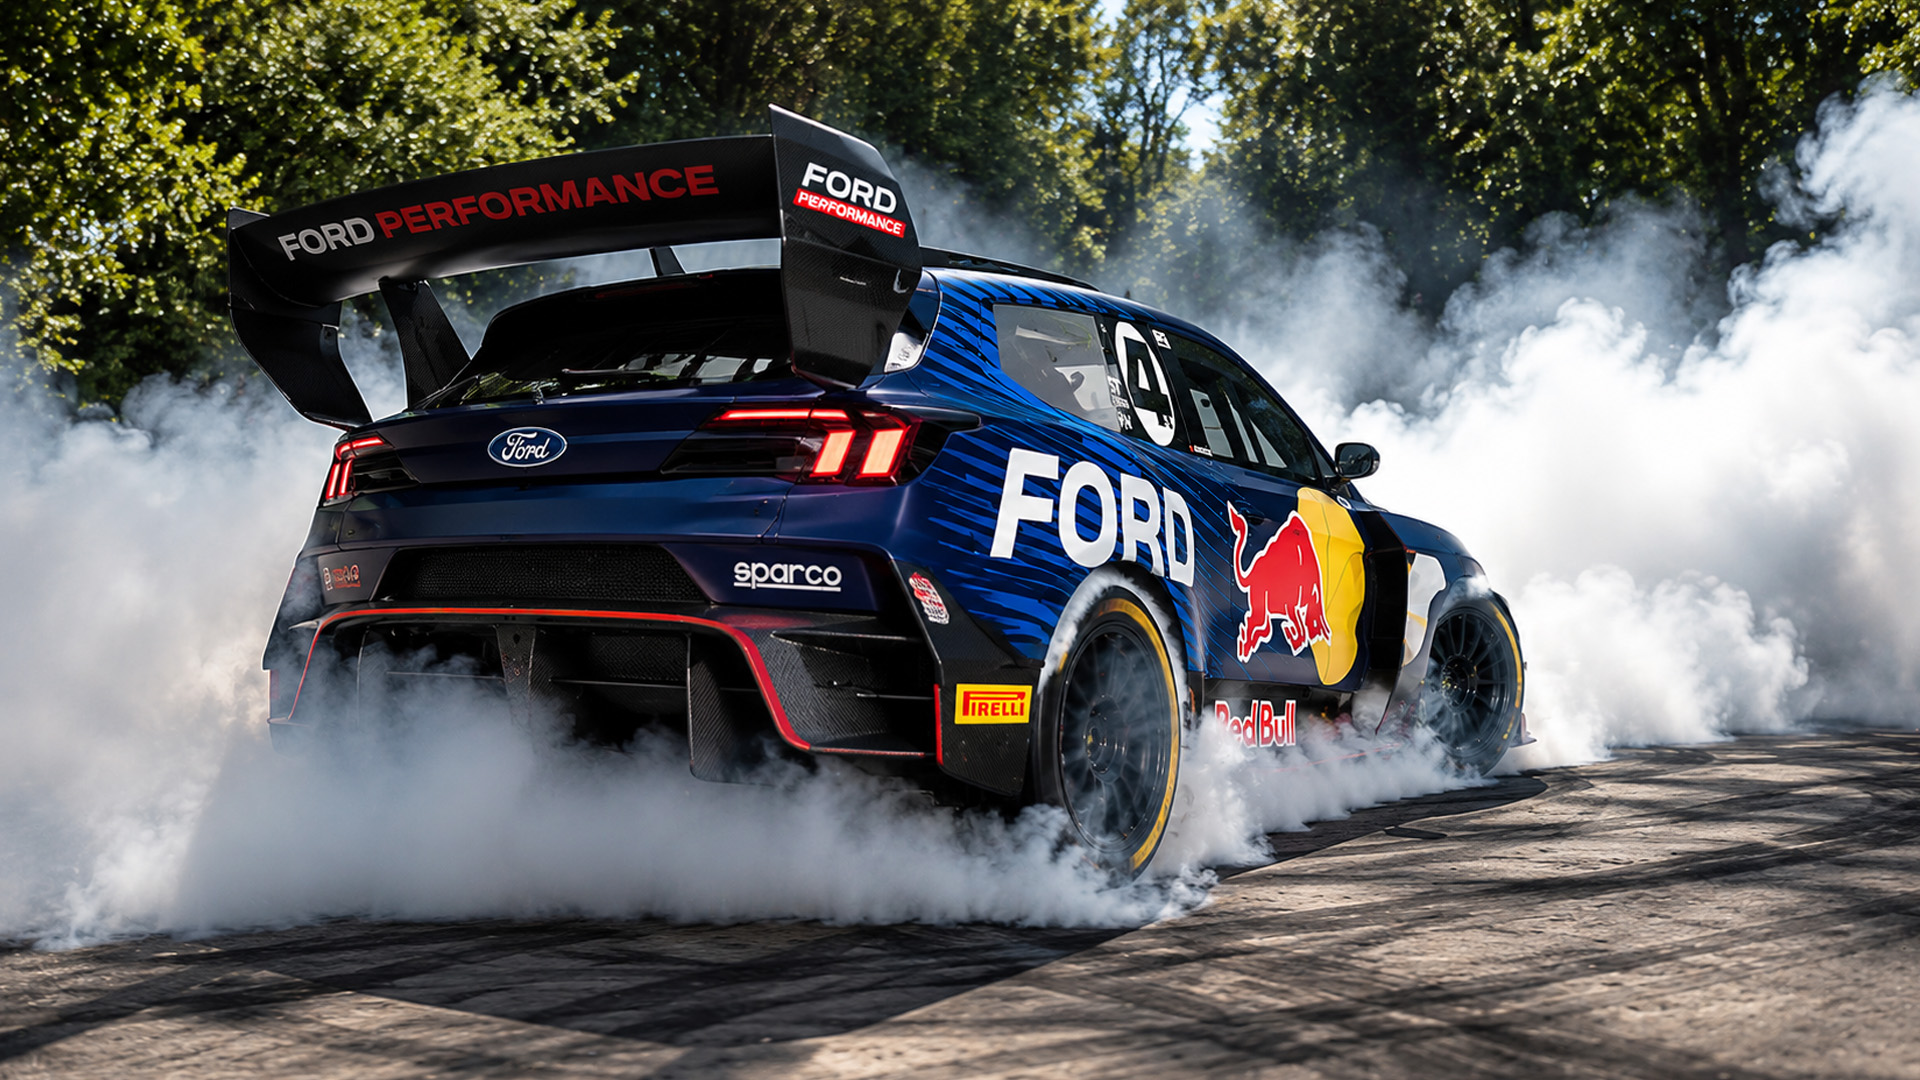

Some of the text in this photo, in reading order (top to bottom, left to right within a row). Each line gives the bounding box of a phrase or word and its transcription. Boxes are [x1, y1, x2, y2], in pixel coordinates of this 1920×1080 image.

[801, 162, 897, 214] FORD
[278, 165, 719, 261] FORD PERFORMANCE
[798, 191, 902, 235] PERFORMANCE
[1123, 336, 1174, 430] 4
[501, 432, 550, 461] Ford
[990, 447, 1195, 587] FORD
[734, 561, 842, 589] sparco
[962, 691, 1026, 716] PIRELLI
[1260, 700, 1296, 747] Bull
